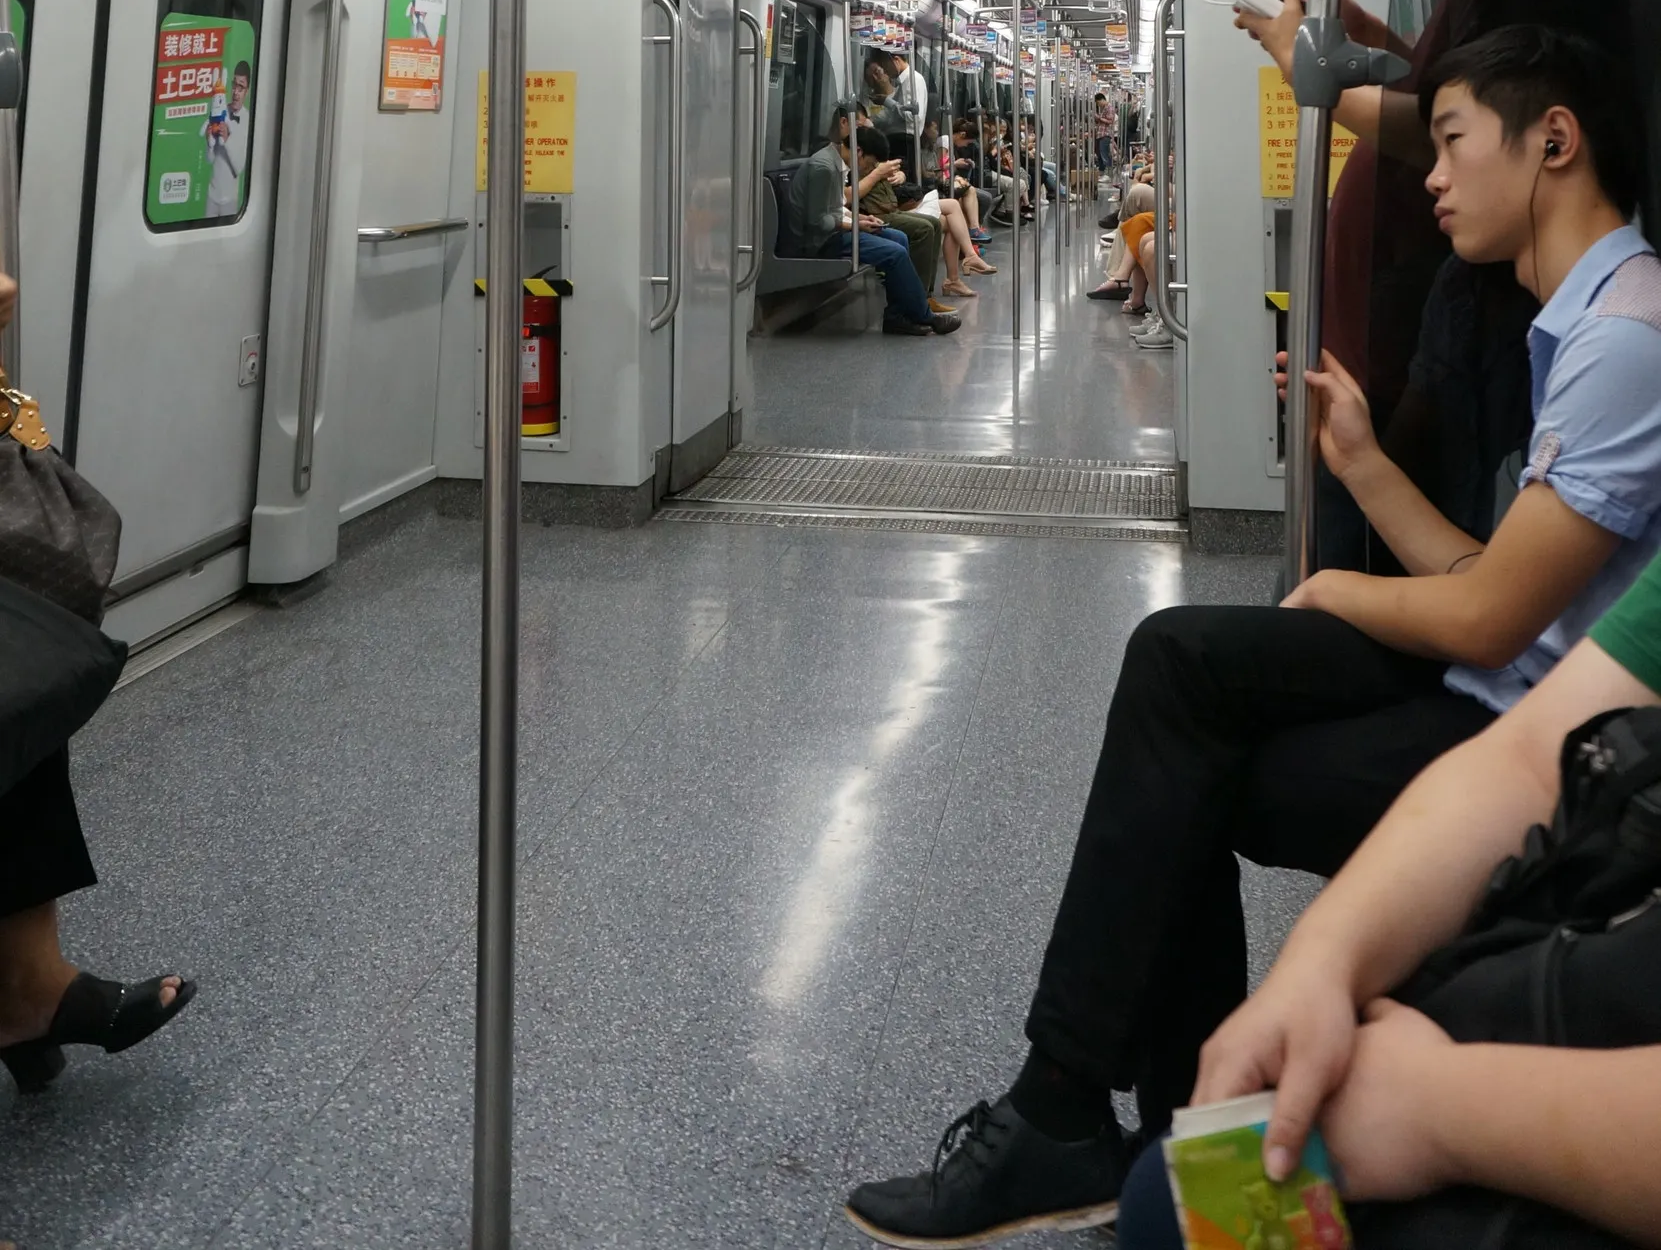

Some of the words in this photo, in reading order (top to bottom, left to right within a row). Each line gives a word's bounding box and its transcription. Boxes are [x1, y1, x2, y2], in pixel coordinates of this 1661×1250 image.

[164, 32, 218, 57] 装修就上
[158, 67, 213, 100] 土巴兔
[537, 137, 568, 146] OPERATION
